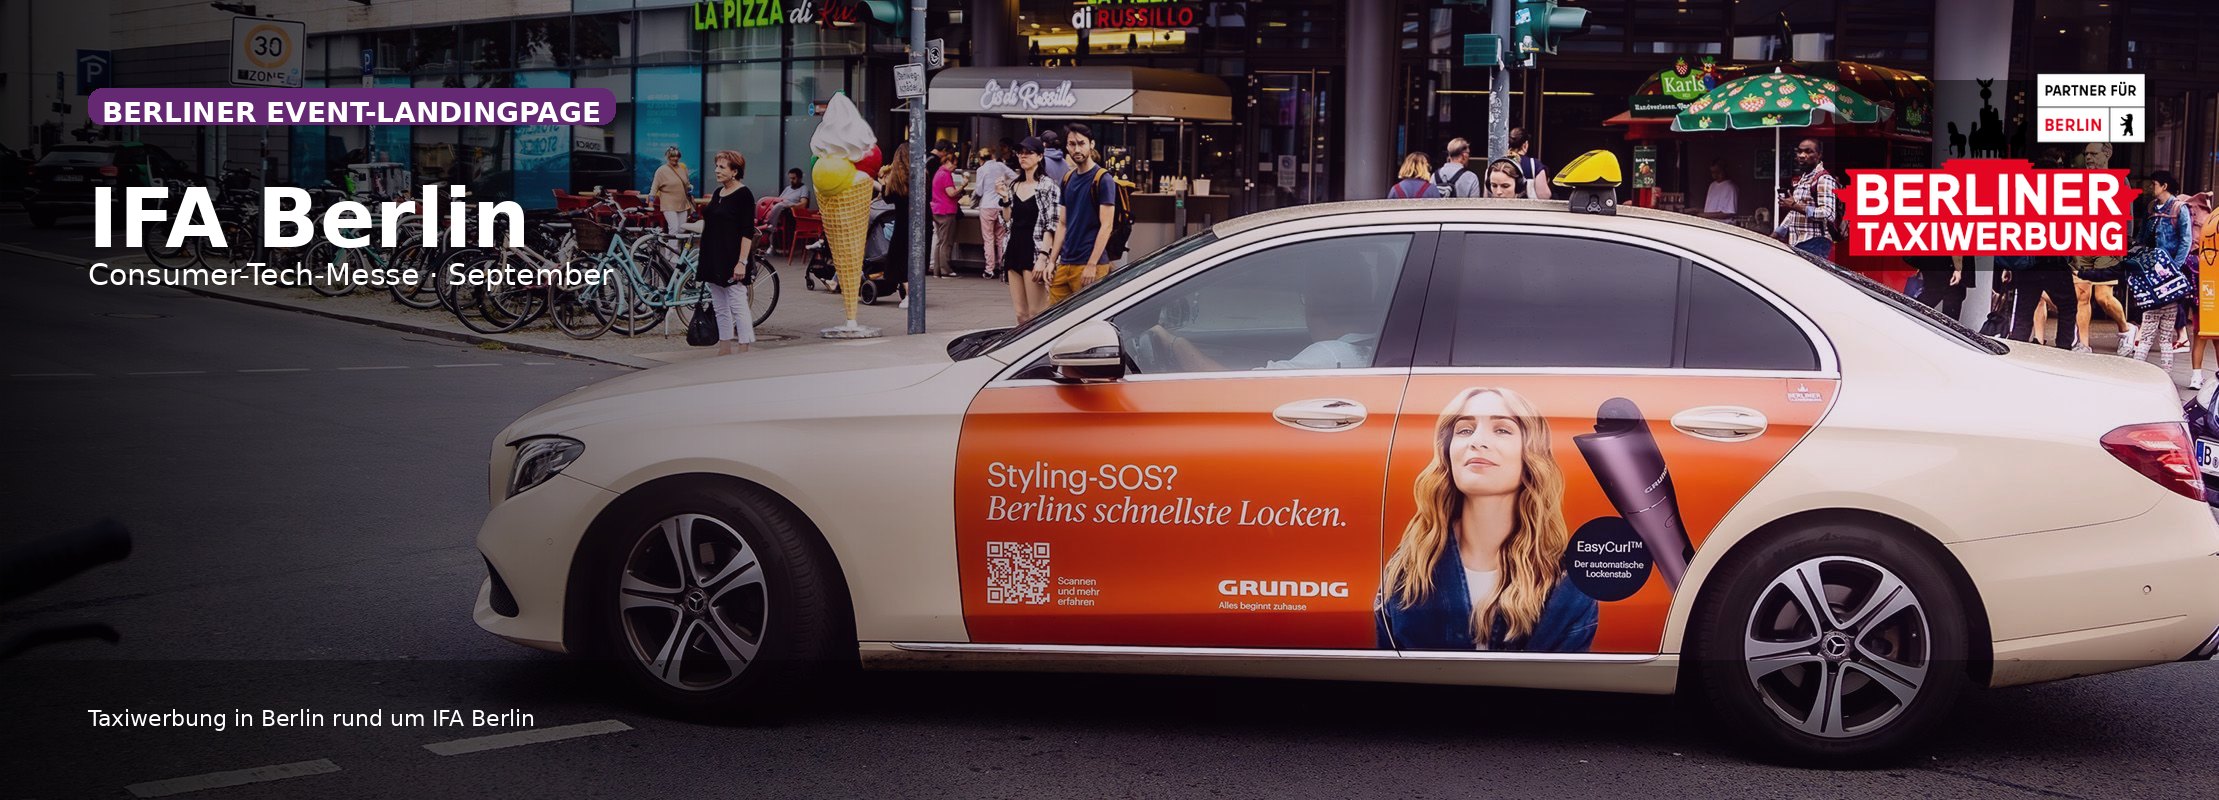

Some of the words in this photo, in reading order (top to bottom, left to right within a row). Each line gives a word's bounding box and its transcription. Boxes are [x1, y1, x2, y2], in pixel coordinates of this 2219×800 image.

[694, 3, 719, 30] LA
[723, 0, 784, 29] PIZZA
[789, 0, 814, 24] di
[1071, 6, 1092, 29] di
[1097, 7, 1194, 28] RUSSILLO
[254, 35, 283, 57] 30
[87, 61, 103, 83] P
[980, 78, 1005, 110] Eis
[1003, 79, 1020, 106] di
[1018, 80, 1078, 110] Russillo
[1663, 77, 1706, 93] Karls
[2203, 445, 2213, 466] B
[987, 460, 1179, 496] Styling-SOS?
[986, 494, 1088, 523] Berlins
[1092, 495, 1233, 526] schnellste
[1237, 498, 1347, 528] Locken.
[1574, 559, 1589, 569] Der
[1588, 560, 1645, 570] automatische
[1585, 569, 1633, 579] Lockenstab
[1057, 576, 1097, 586] Scannen
[1217, 579, 1349, 598] GRUNDIG
[1057, 586, 1076, 596] und
[1076, 587, 1101, 597] mehr
[1057, 596, 1095, 607] erfahren
[1218, 601, 1239, 610] Alles
[1239, 601, 1272, 612] beginnt
[1272, 602, 1307, 612] zuhause
